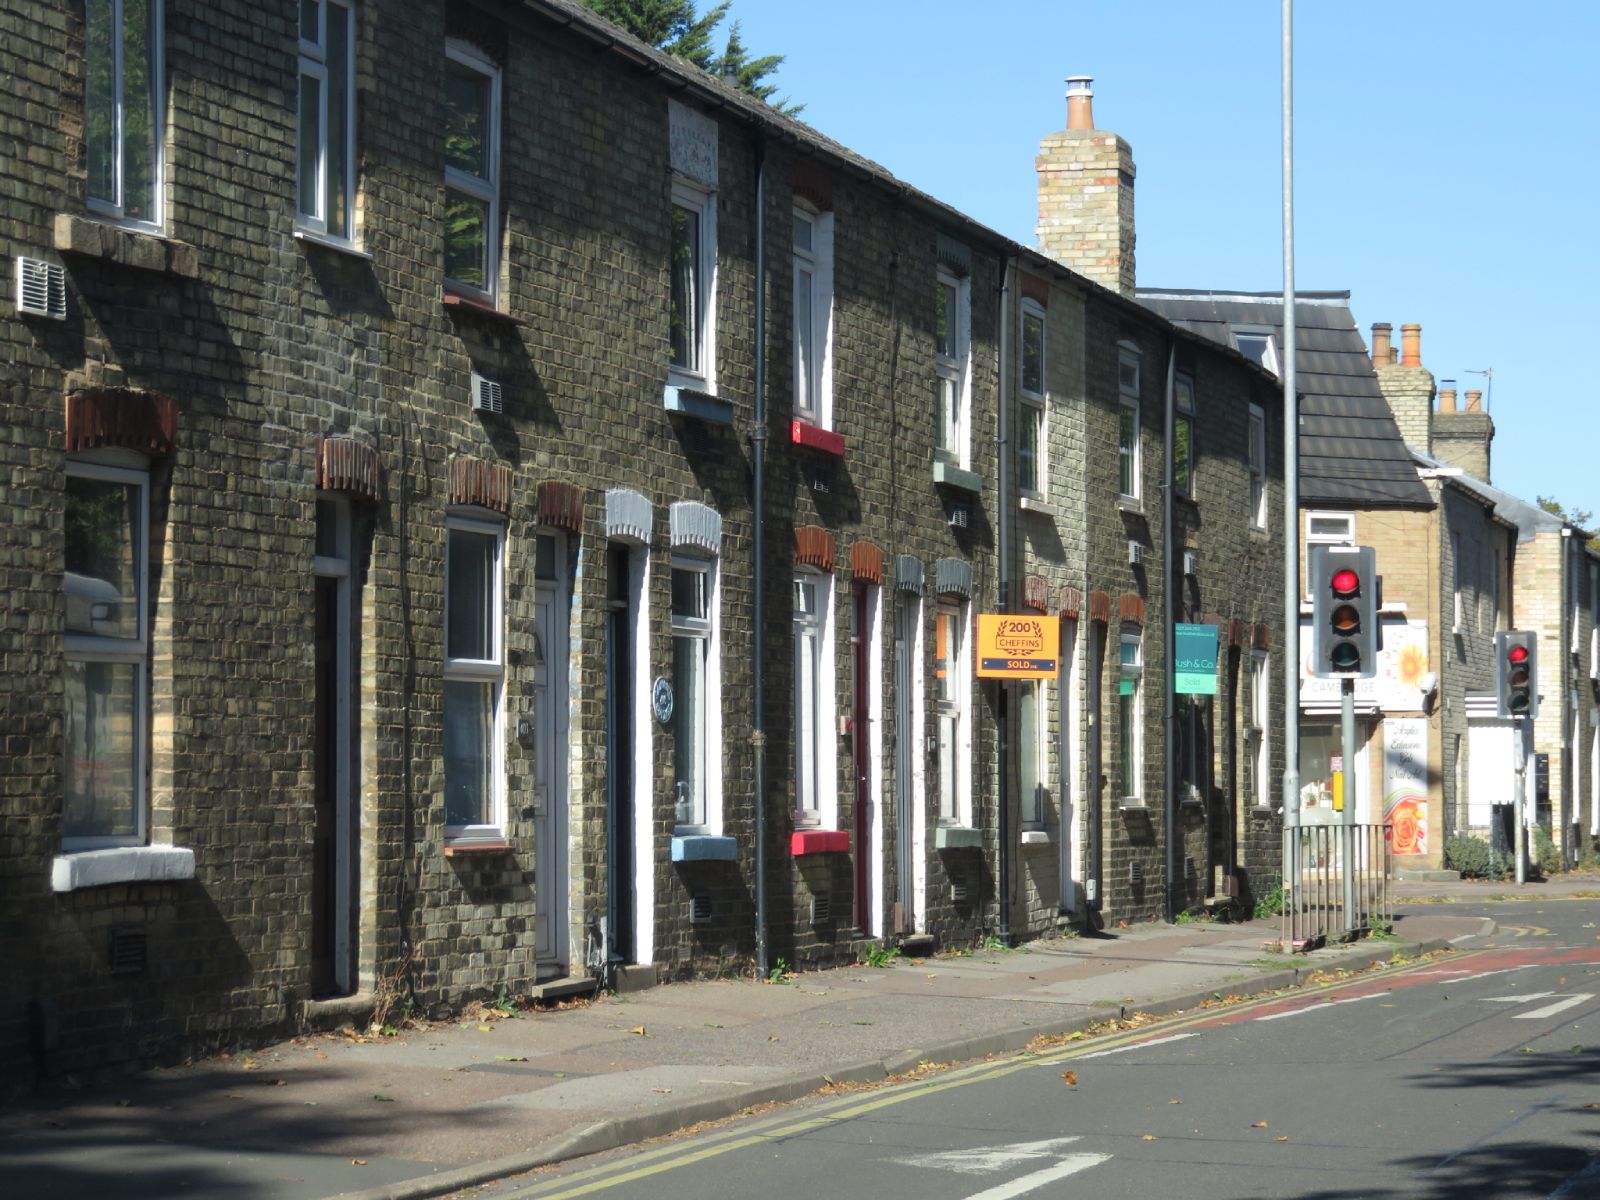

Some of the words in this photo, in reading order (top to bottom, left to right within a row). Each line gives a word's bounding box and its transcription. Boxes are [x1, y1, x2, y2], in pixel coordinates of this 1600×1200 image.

[1009, 622, 1030, 632] 200
[1000, 639, 1040, 647] CHEFFINS
[1007, 660, 1030, 669] SOLD
[1312, 682, 1375, 693] CAMBDGE
